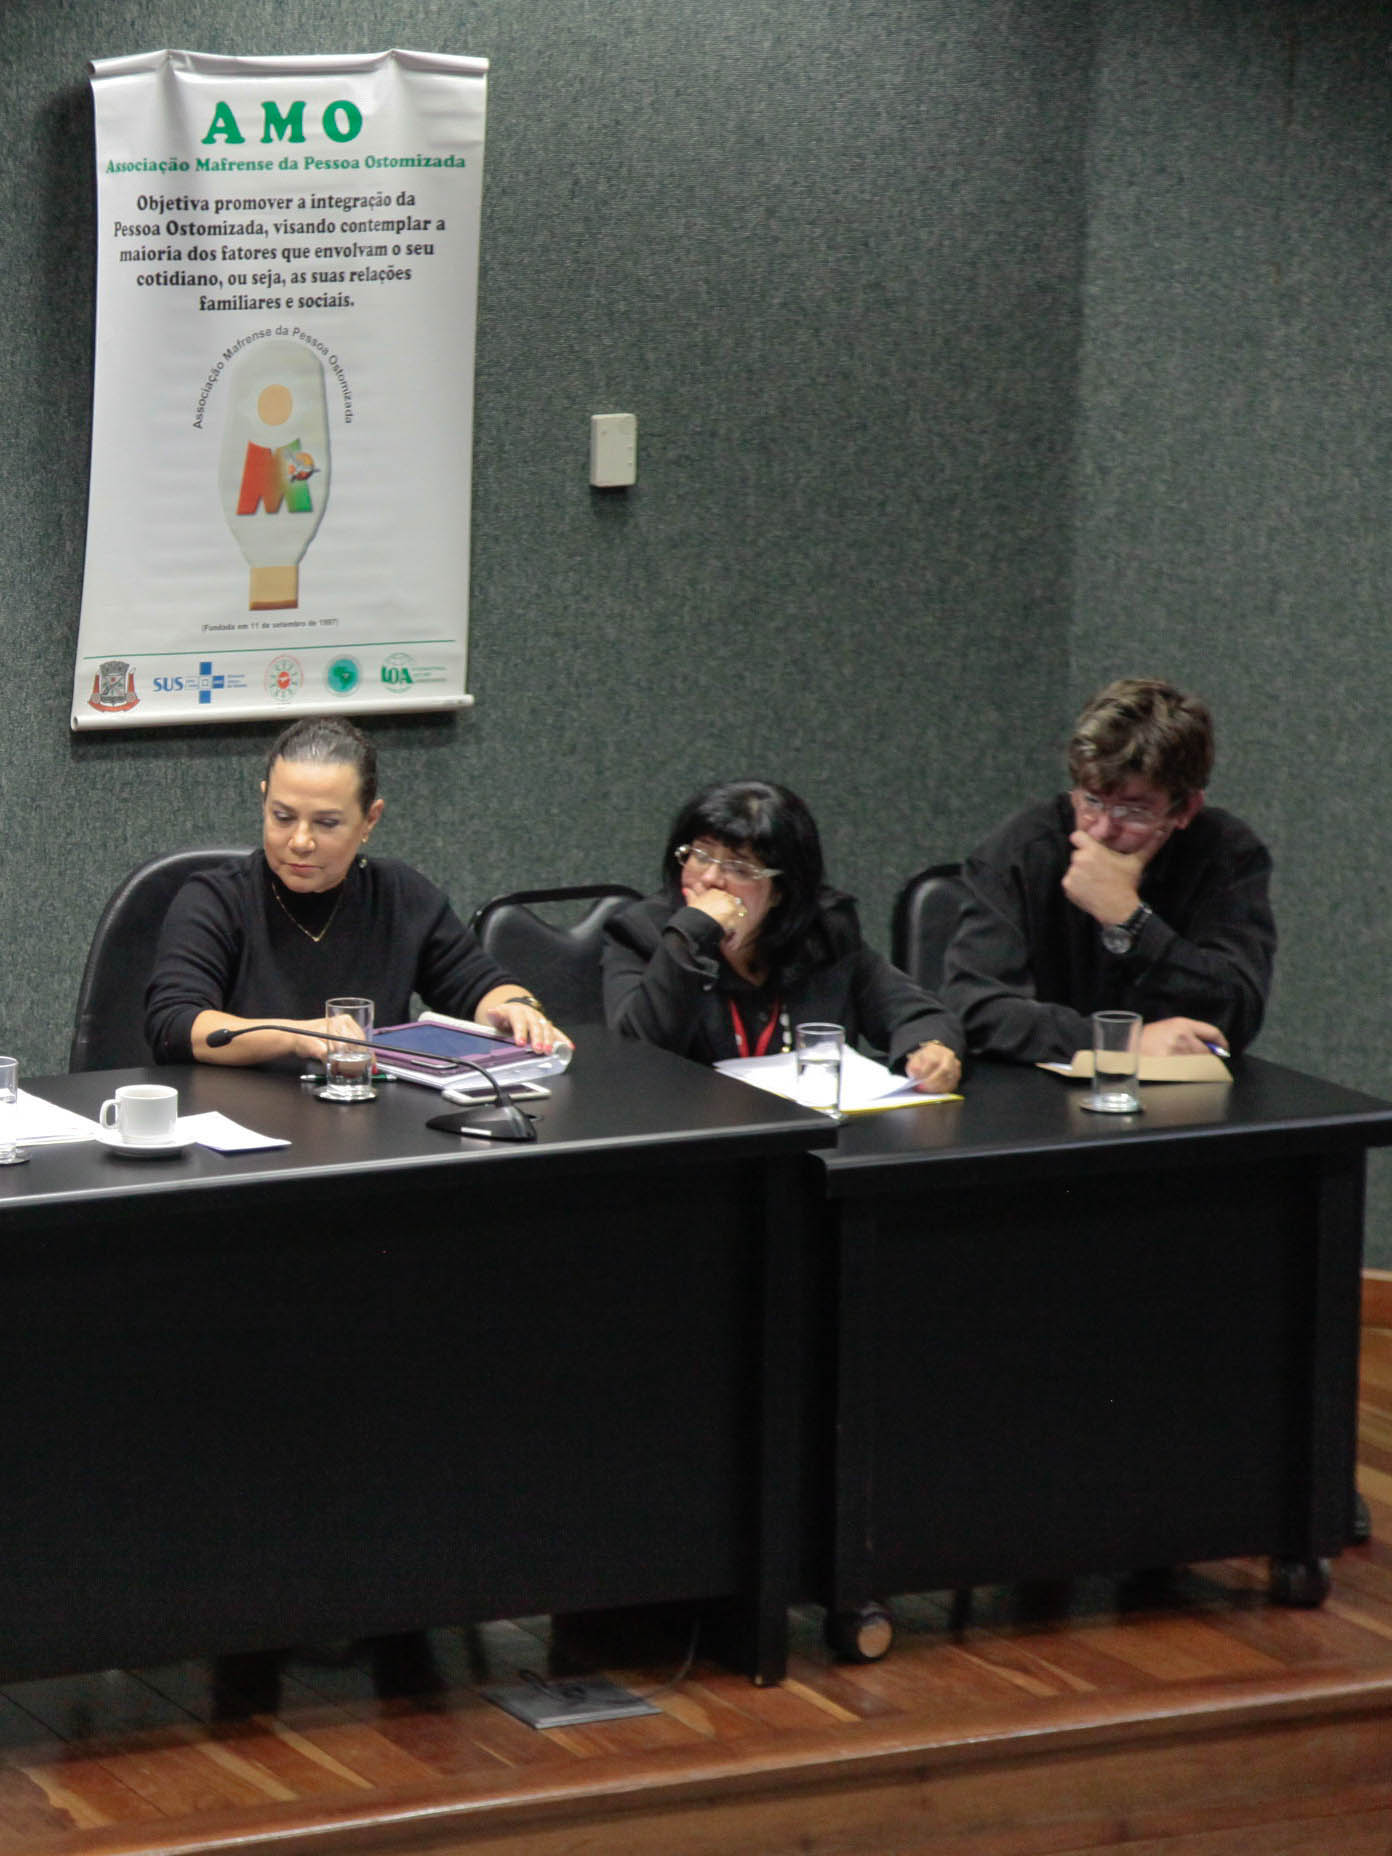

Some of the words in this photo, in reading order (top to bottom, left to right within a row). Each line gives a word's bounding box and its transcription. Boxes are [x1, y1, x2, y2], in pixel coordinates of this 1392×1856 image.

[106, 158, 190, 174] Associação
[195, 157, 273, 172] Mafrense
[278, 156, 298, 170] da
[304, 156, 360, 170] Pessoa
[365, 154, 465, 169] Ostomizada
[136, 194, 209, 214] Objetiva
[214, 197, 293, 214] promover
[297, 198, 306, 209] a
[311, 192, 392, 212] integração
[396, 191, 416, 206] da
[114, 221, 161, 237] Pessoa
[166, 219, 269, 238] Ostomizada,
[273, 218, 336, 234] visando
[340, 215, 431, 234] contemplar
[436, 219, 446, 231] a
[119, 245, 182, 262] maioria
[187, 246, 217, 261] dos
[221, 245, 277, 261] fatores
[281, 247, 310, 262] que
[314, 242, 388, 258] envolvam
[392, 245, 401, 256] o
[405, 243, 434, 256] seu
[136, 270, 223, 289] cotidiano,
[227, 276, 247, 286] ou
[251, 269, 286, 289] seja,
[290, 272, 307, 284] as
[311, 271, 345, 283] suas
[349, 264, 412, 284] relações
[199, 295, 281, 311] familiares
[285, 297, 294, 309] e
[298, 292, 355, 308] sociais.
[193, 361, 225, 430] Associação
[222, 328, 272, 362] Mafrense
[275, 325, 289, 336] da
[292, 326, 329, 356] Pessoa
[328, 354, 354, 424] Ostomizada
[152, 676, 184, 692] SUS
